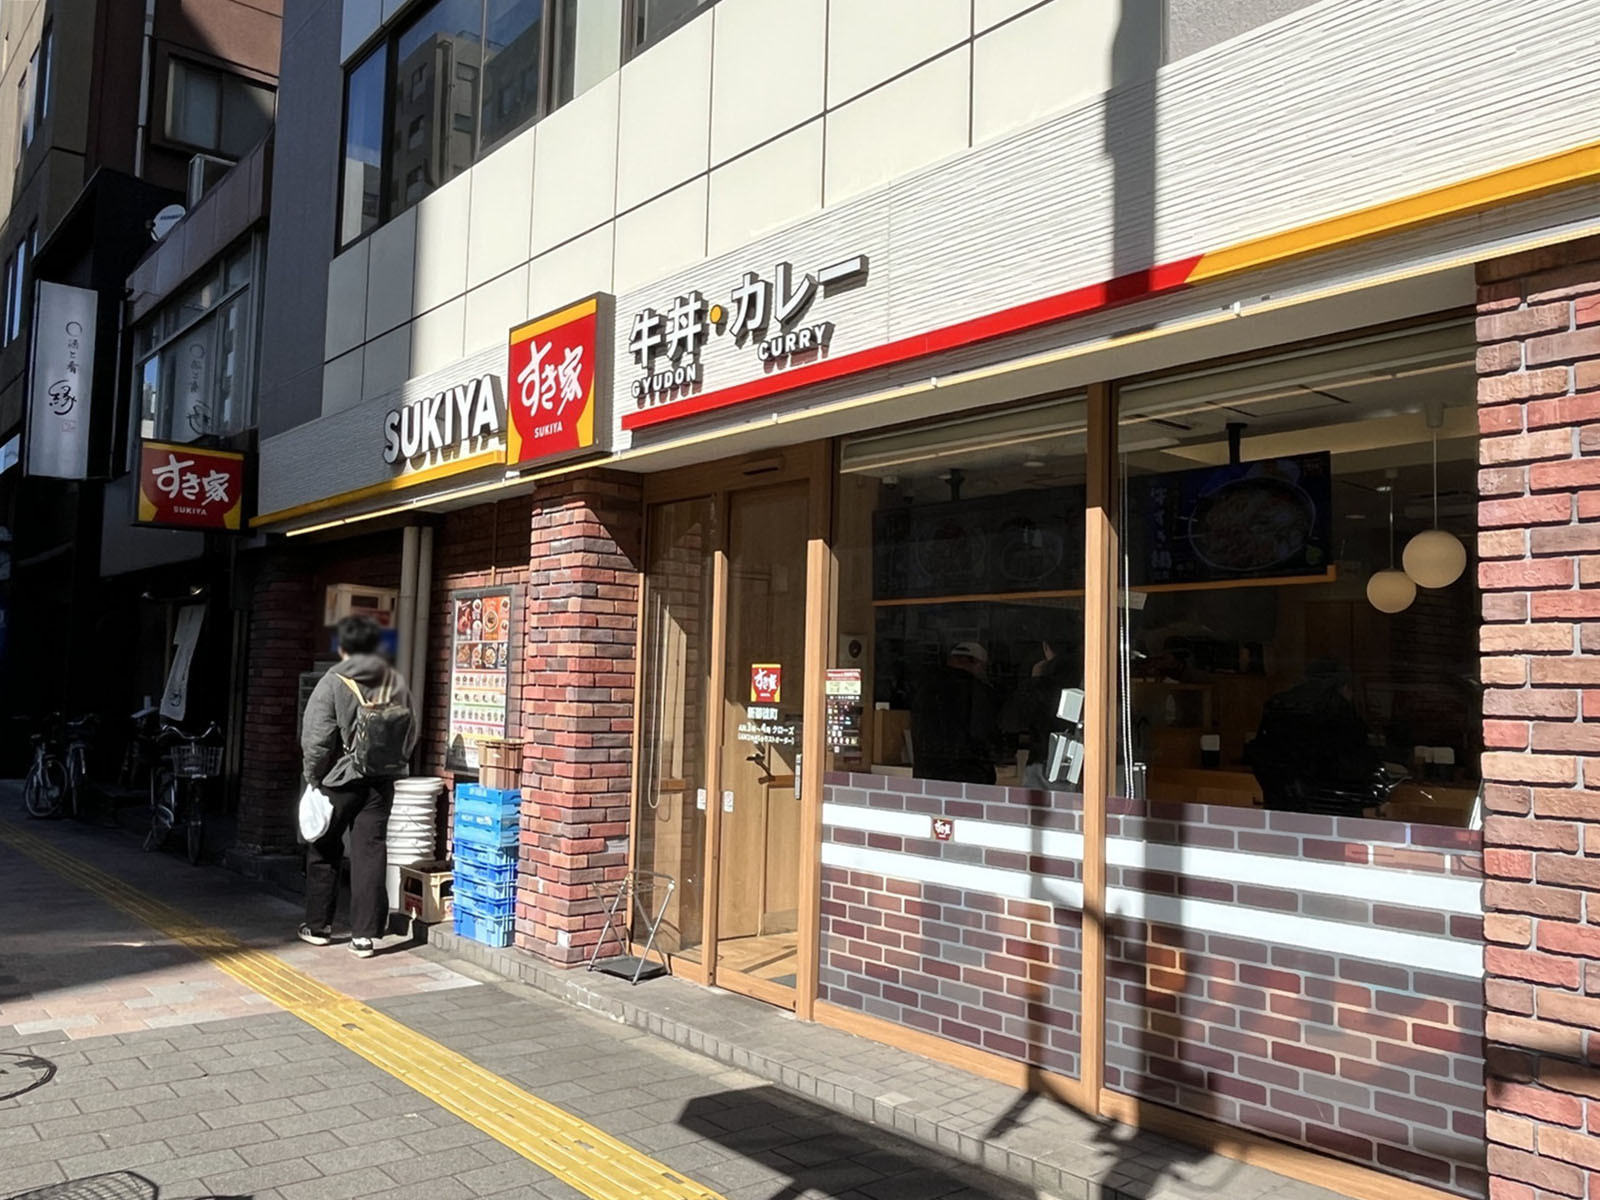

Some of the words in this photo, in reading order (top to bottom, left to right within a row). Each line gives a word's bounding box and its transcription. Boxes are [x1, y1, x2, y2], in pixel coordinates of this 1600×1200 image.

[629, 255, 868, 368] 牛丼・カレー
[758, 323, 829, 361] CURRY
[517, 340, 584, 417] すき家
[631, 362, 699, 398] GYUDON
[383, 373, 500, 464] SUKIYA
[534, 421, 563, 439] SUKIYA
[152, 453, 231, 506] すき家
[173, 505, 208, 516] SUKIYA
